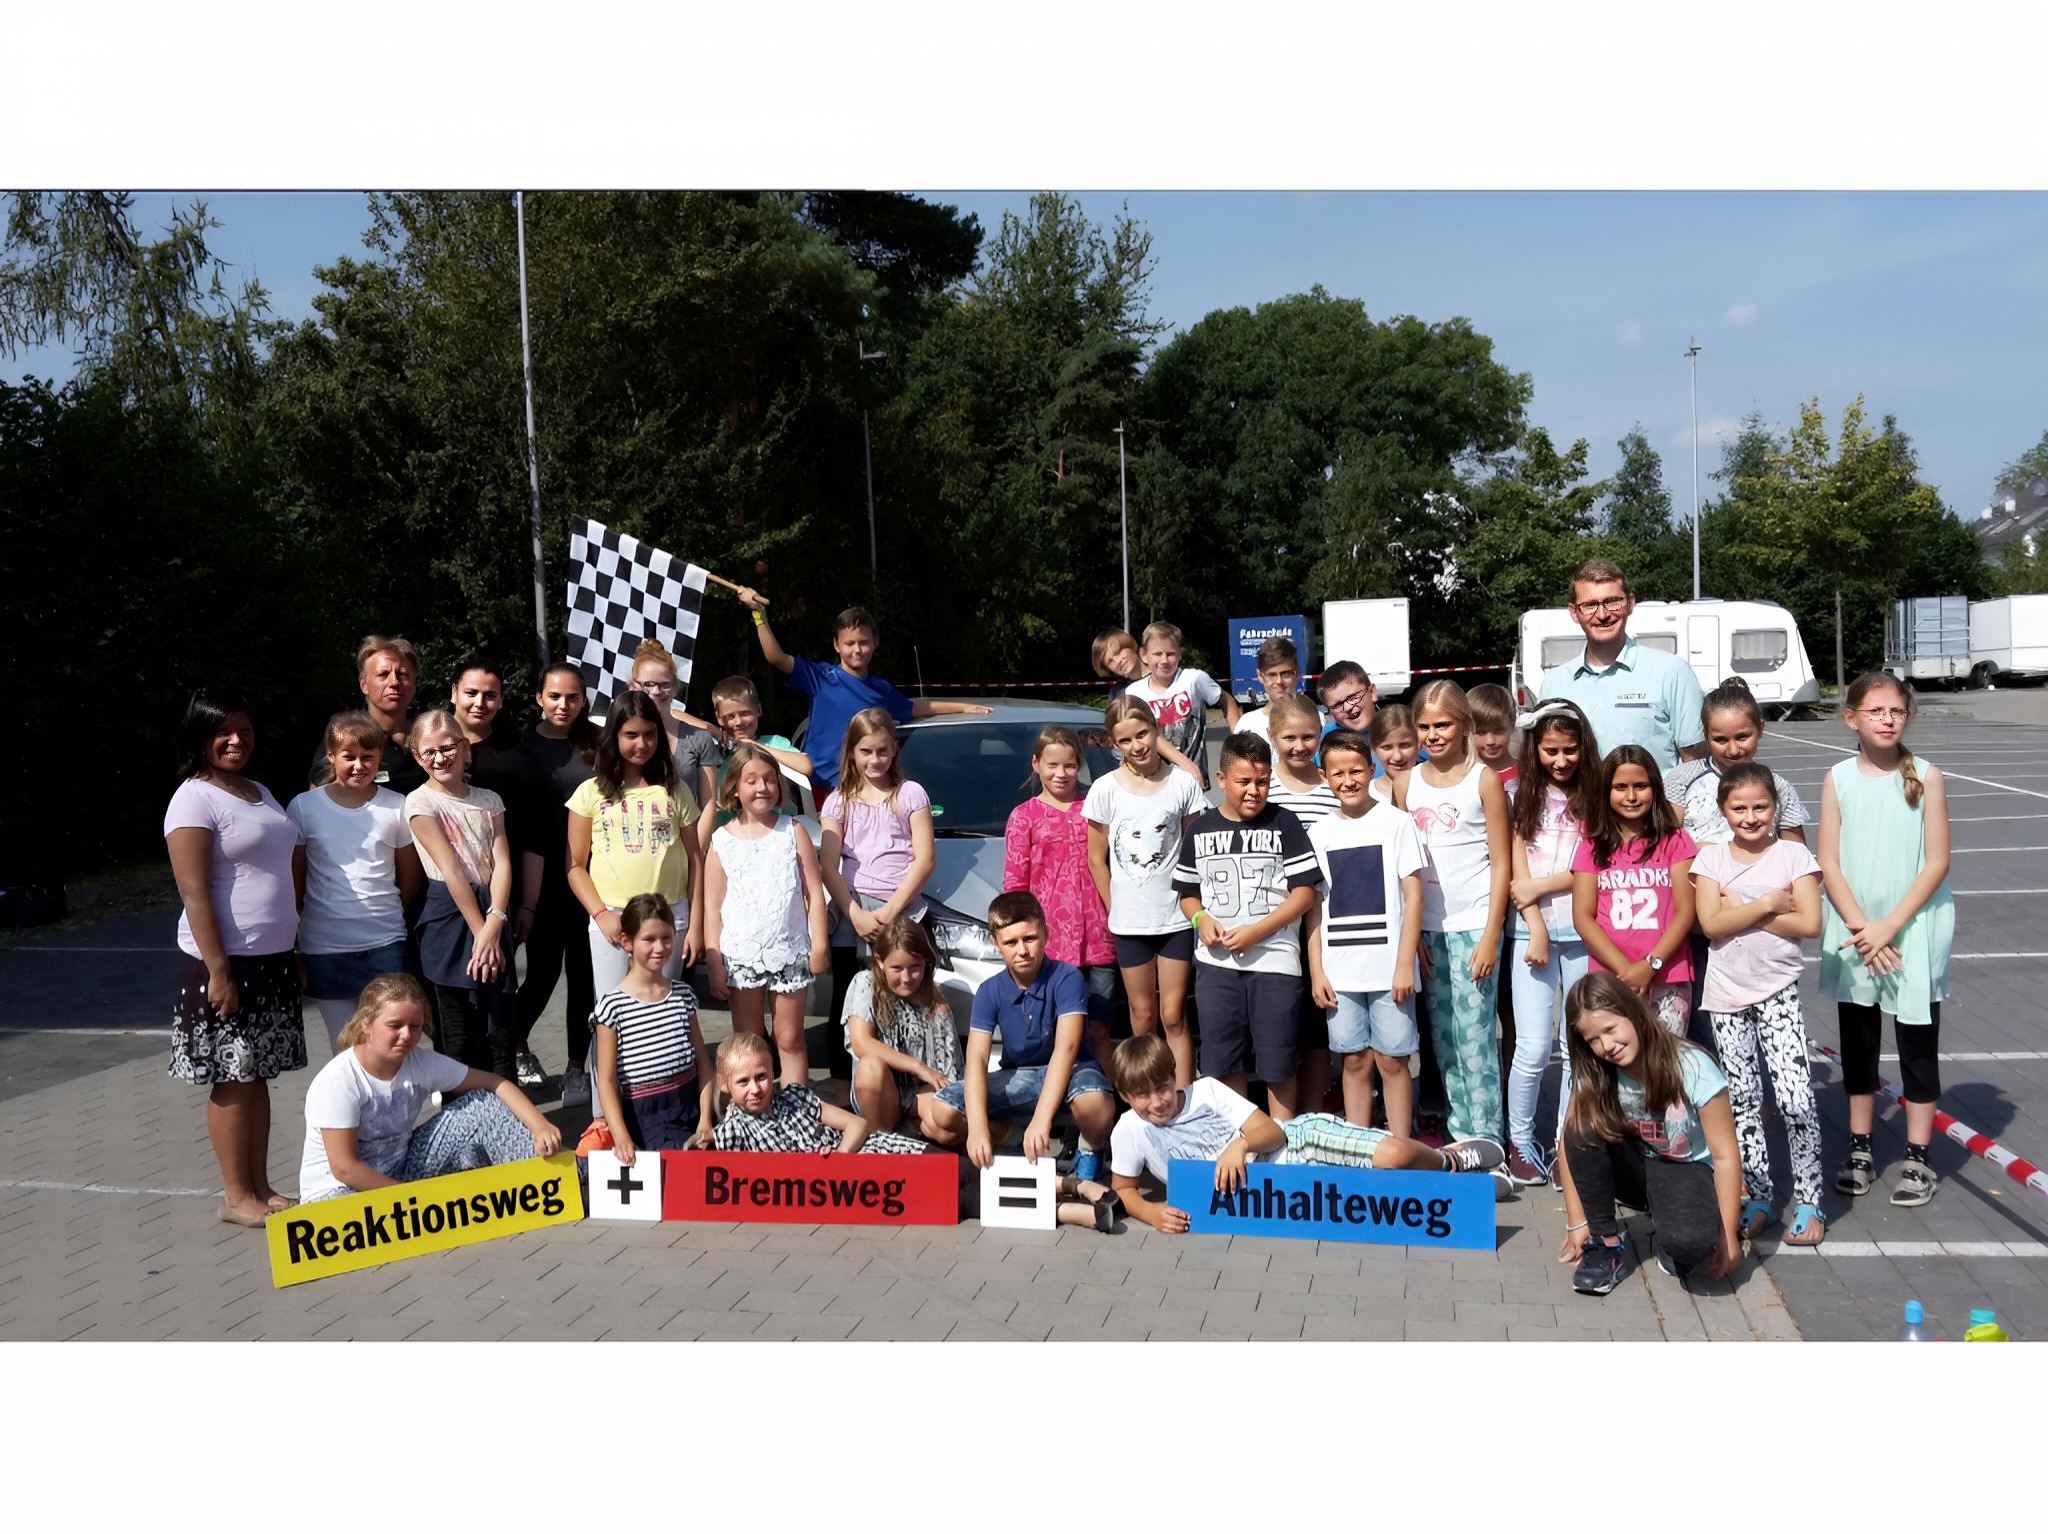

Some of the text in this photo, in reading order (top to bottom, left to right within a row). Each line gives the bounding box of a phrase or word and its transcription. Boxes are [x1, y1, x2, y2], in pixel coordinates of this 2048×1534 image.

[1193, 831, 1235, 858] NEW
[1206, 856, 1277, 918] 97
[1609, 888, 1659, 930] 82
[705, 1166, 906, 1217] Bremsweg
[1209, 1178, 1453, 1239] Anhalteweg
[286, 1178, 565, 1265] Reaktionsweg
